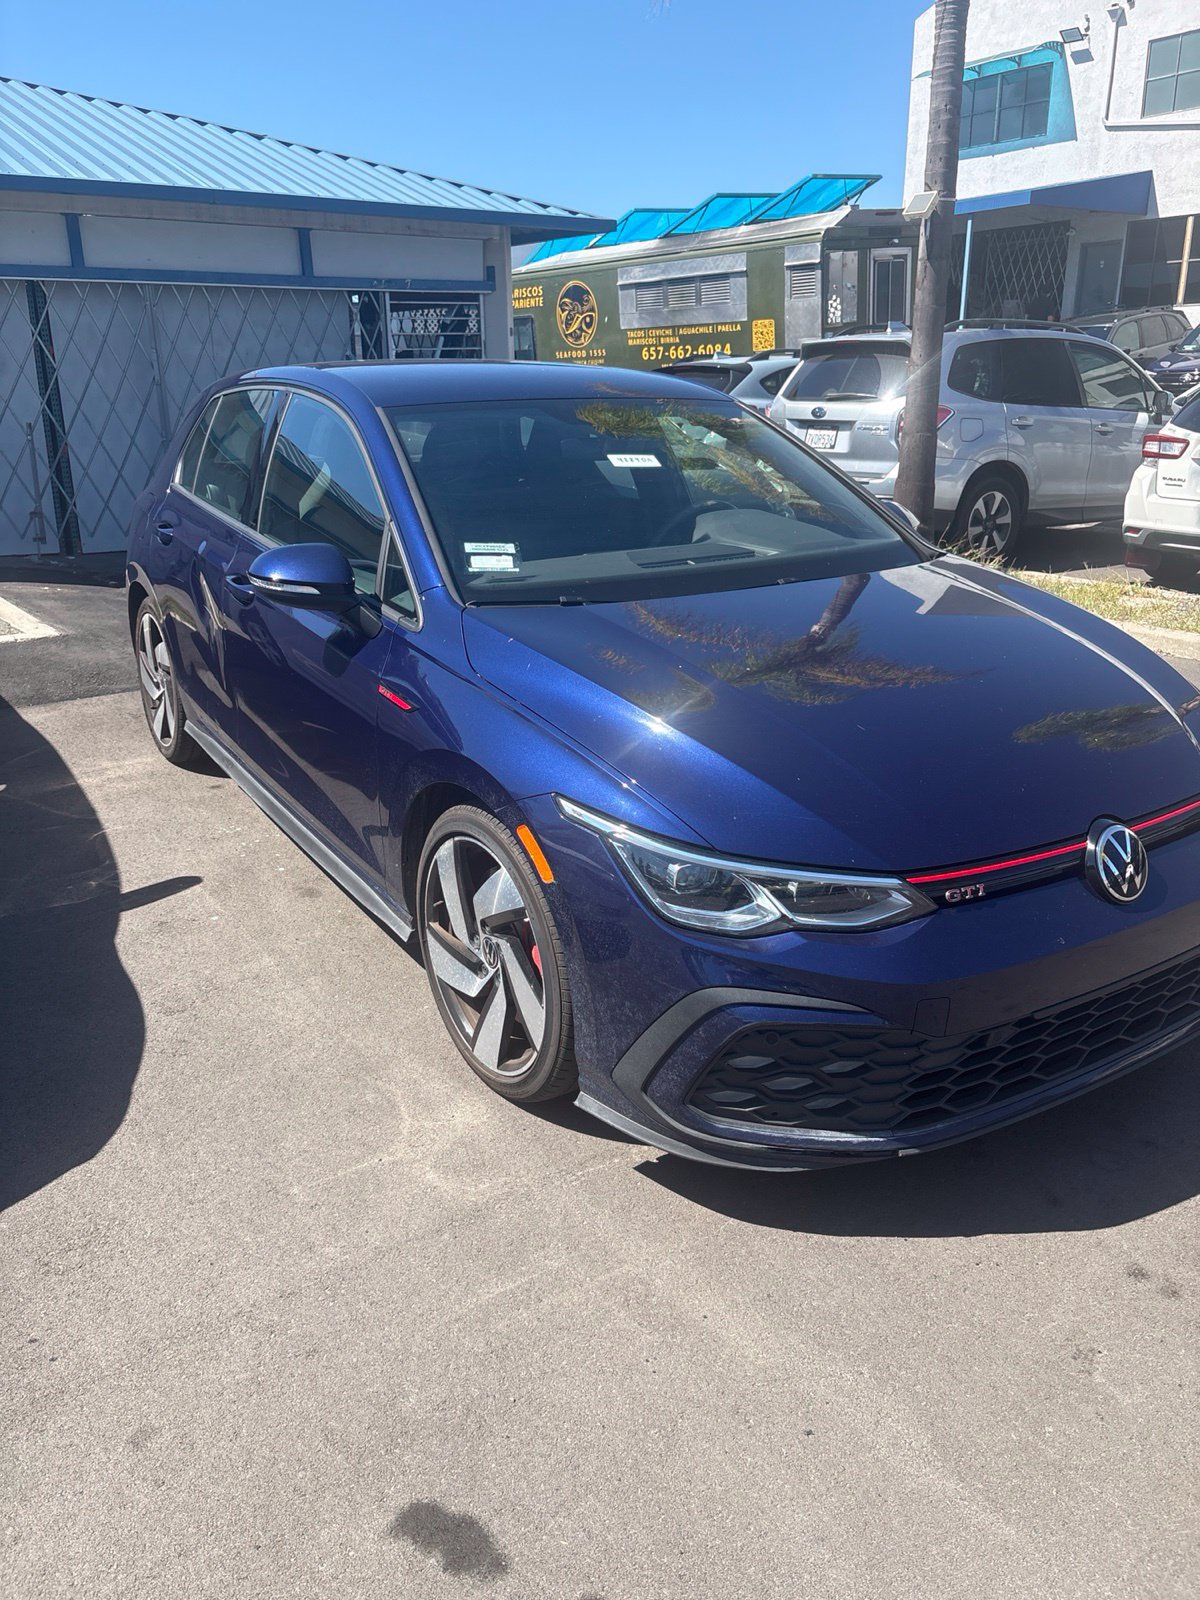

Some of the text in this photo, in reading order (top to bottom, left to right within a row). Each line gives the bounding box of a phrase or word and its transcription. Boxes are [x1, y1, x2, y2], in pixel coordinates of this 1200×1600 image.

[627, 324, 742, 338] TACOS CEVICHE AGUACHILE PAELLA
[628, 337, 656, 346] MARISCOS
[556, 350, 586, 359] SEAFOOD
[945, 883, 986, 903] GTI
